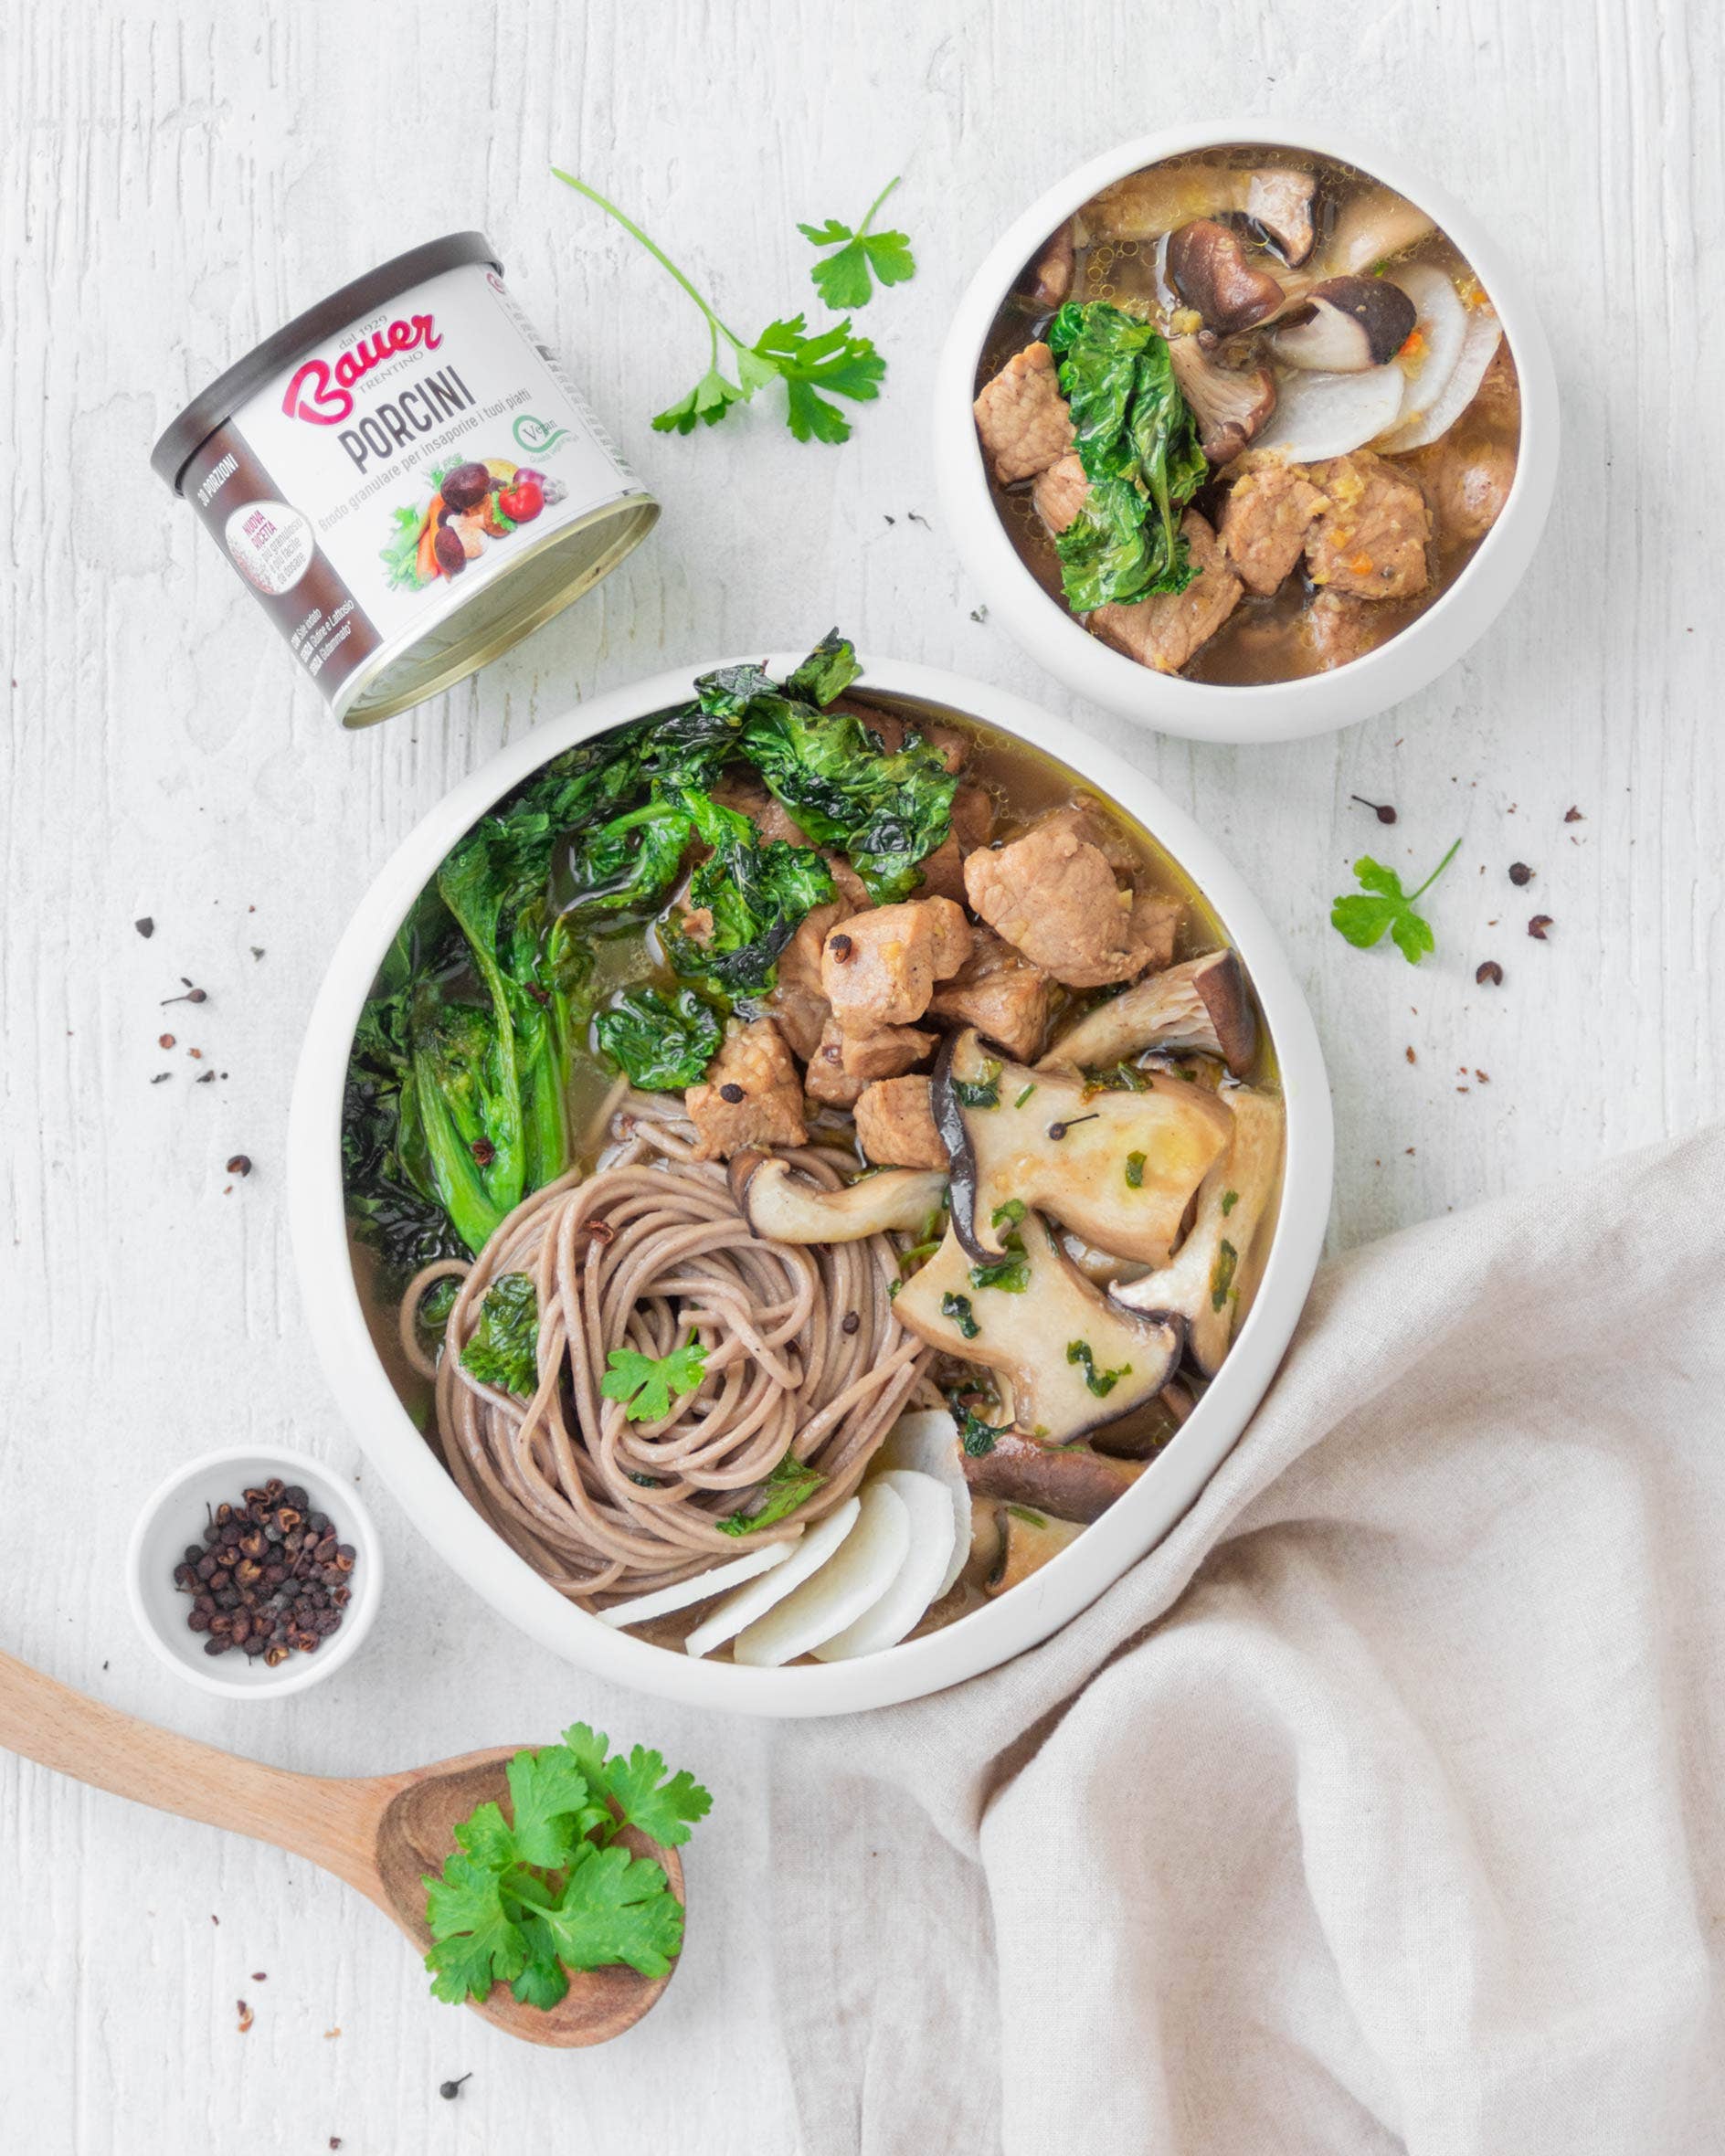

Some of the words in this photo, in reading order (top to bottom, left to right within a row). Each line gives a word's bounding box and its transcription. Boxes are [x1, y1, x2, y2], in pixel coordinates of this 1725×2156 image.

[339, 334, 357, 350] dal
[359, 315, 387, 337] 1929
[281, 314, 443, 426] Bauer
[359, 351, 423, 394] TRENTINO
[337, 365, 476, 475] PORCINI
[522, 417, 558, 441] Vegan
[318, 503, 349, 532] Brodo
[348, 462, 401, 510] granulare
[401, 450, 422, 473] per
[422, 417, 479, 457] insaporire
[485, 403, 506, 419] tuoi
[507, 388, 532, 410] piatti
[202, 453, 238, 498] PORZIONI
[242, 509, 266, 535] NUOVA
[250, 521, 277, 550] RICETTA
[280, 536, 302, 564] facile
[283, 552, 306, 578] dosare
[325, 621, 332, 631] e
[328, 599, 355, 627] Lattosio
